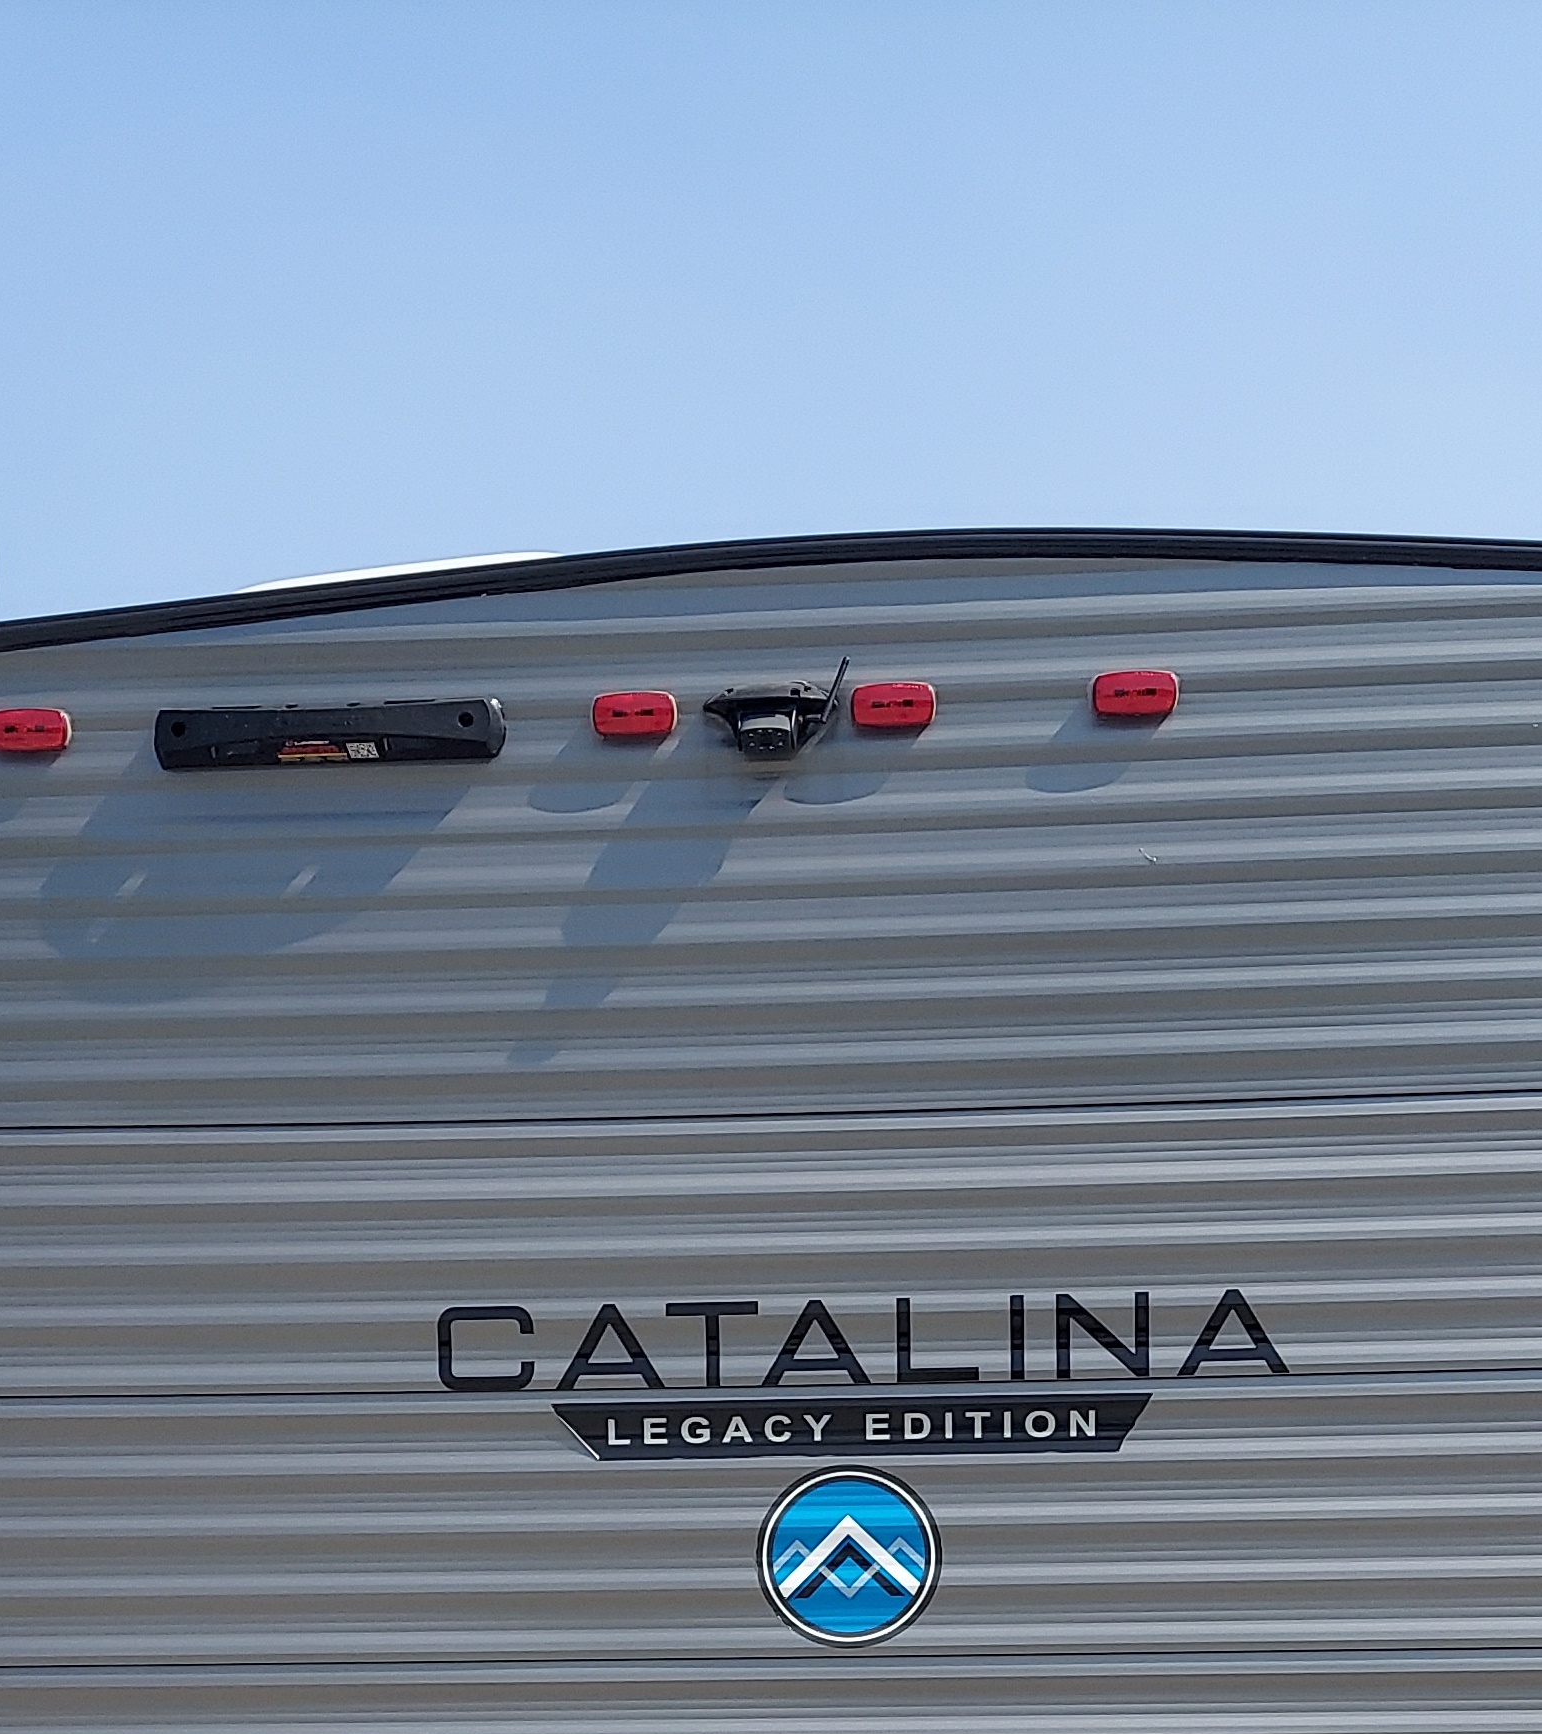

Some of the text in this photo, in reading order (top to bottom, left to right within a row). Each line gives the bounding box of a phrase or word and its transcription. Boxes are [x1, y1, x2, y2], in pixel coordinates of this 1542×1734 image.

[437, 1289, 1290, 1391] CATALINA
[607, 1409, 1097, 1446] LEGACY EDITION
